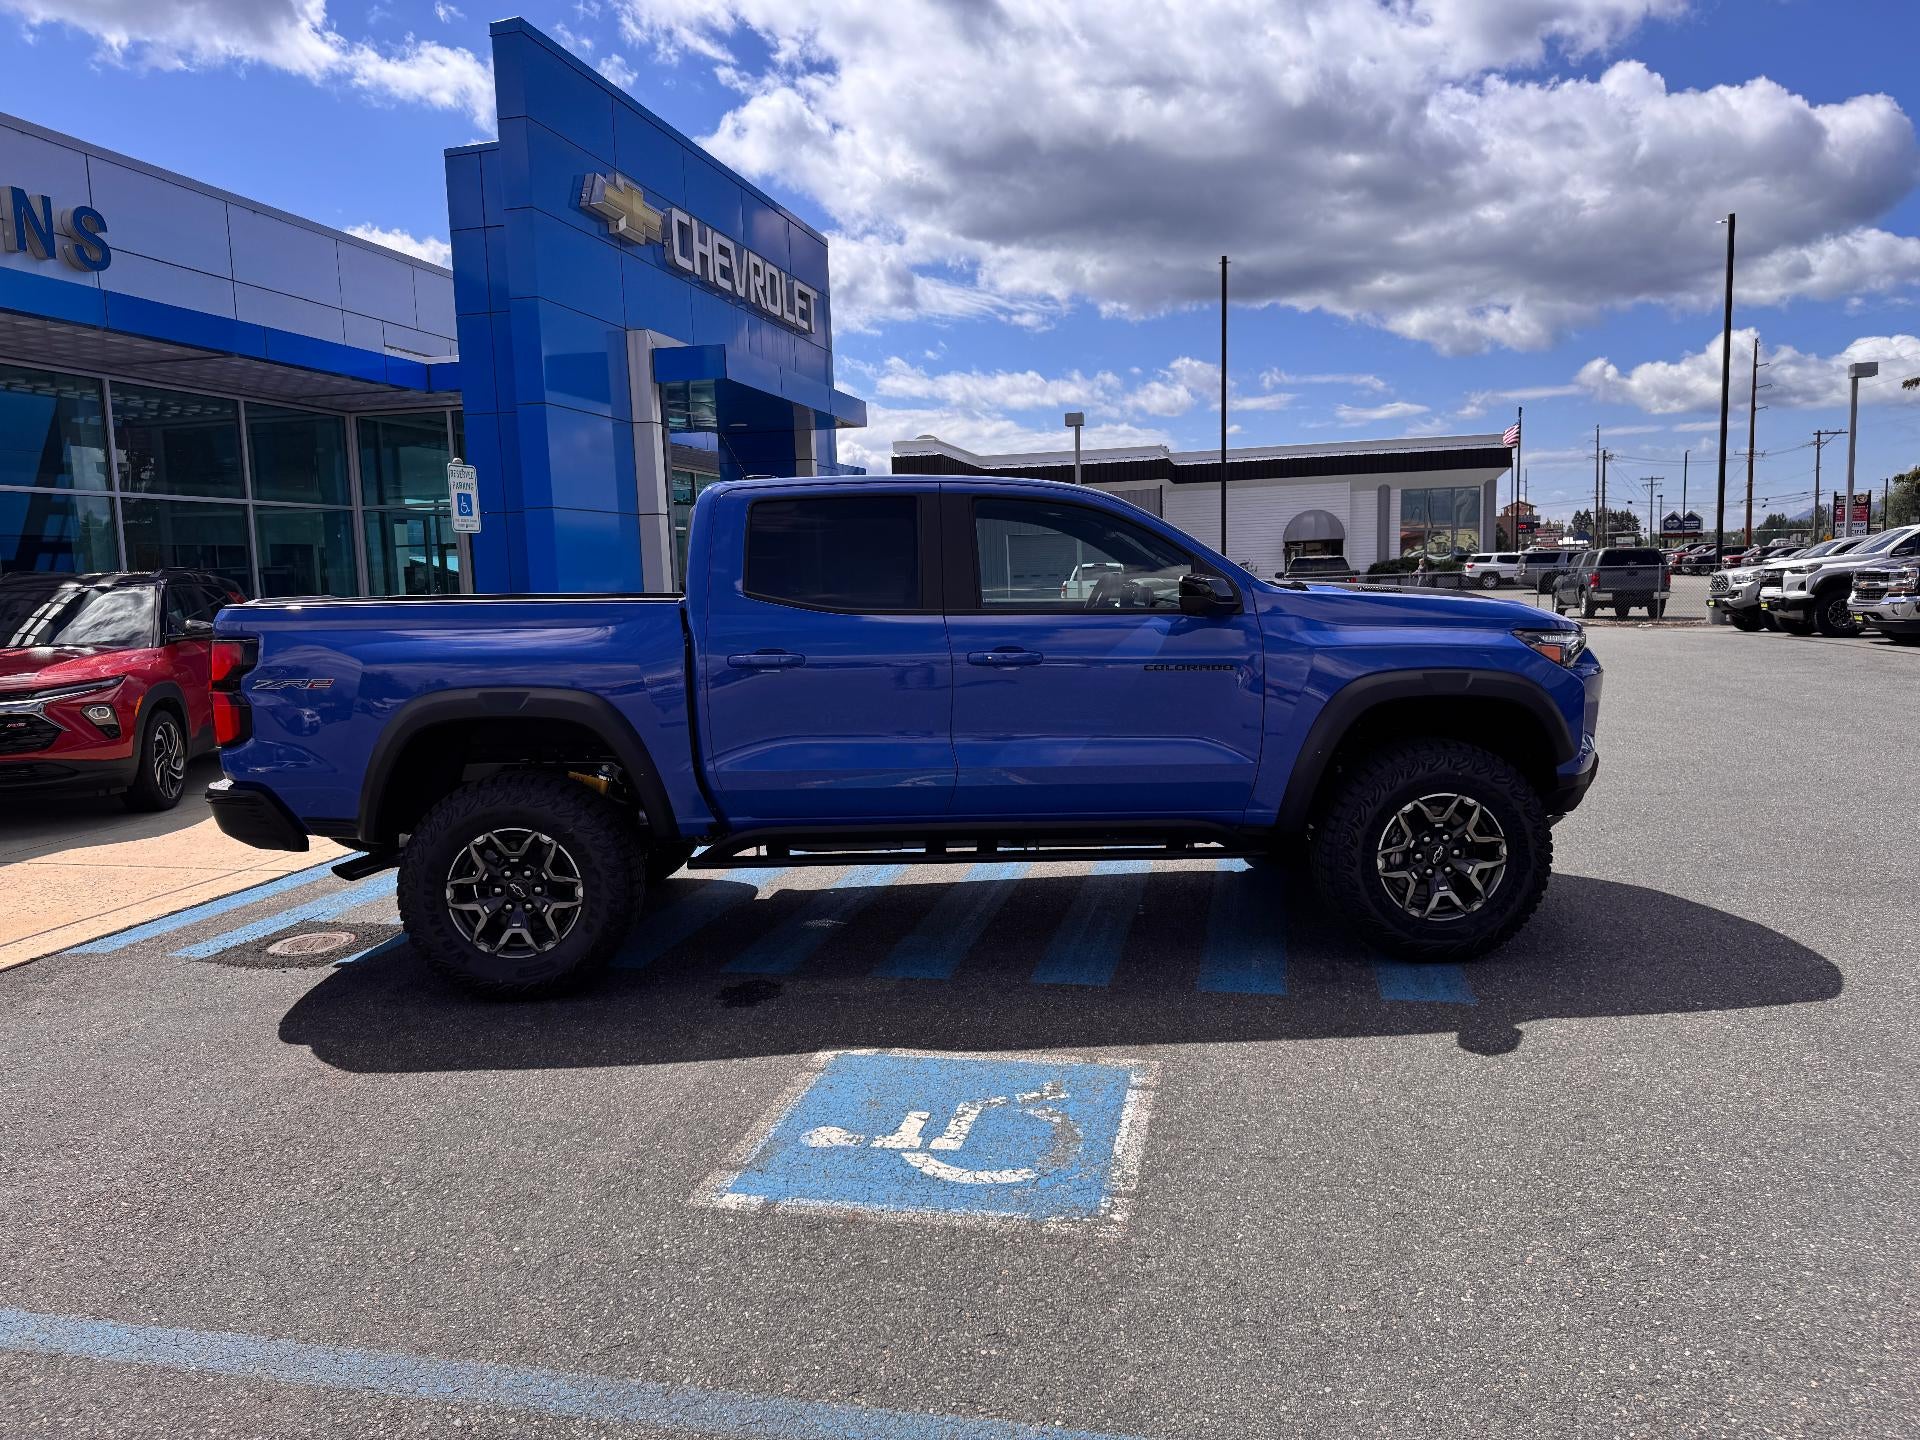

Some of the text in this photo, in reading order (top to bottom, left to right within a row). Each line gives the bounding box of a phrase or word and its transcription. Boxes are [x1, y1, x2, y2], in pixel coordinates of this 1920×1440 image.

[664, 207, 818, 334] CHEVROLET
[452, 481, 475, 492] PARKING
[1143, 664, 1235, 672] COLORADO
[252, 678, 335, 690] ZR2
